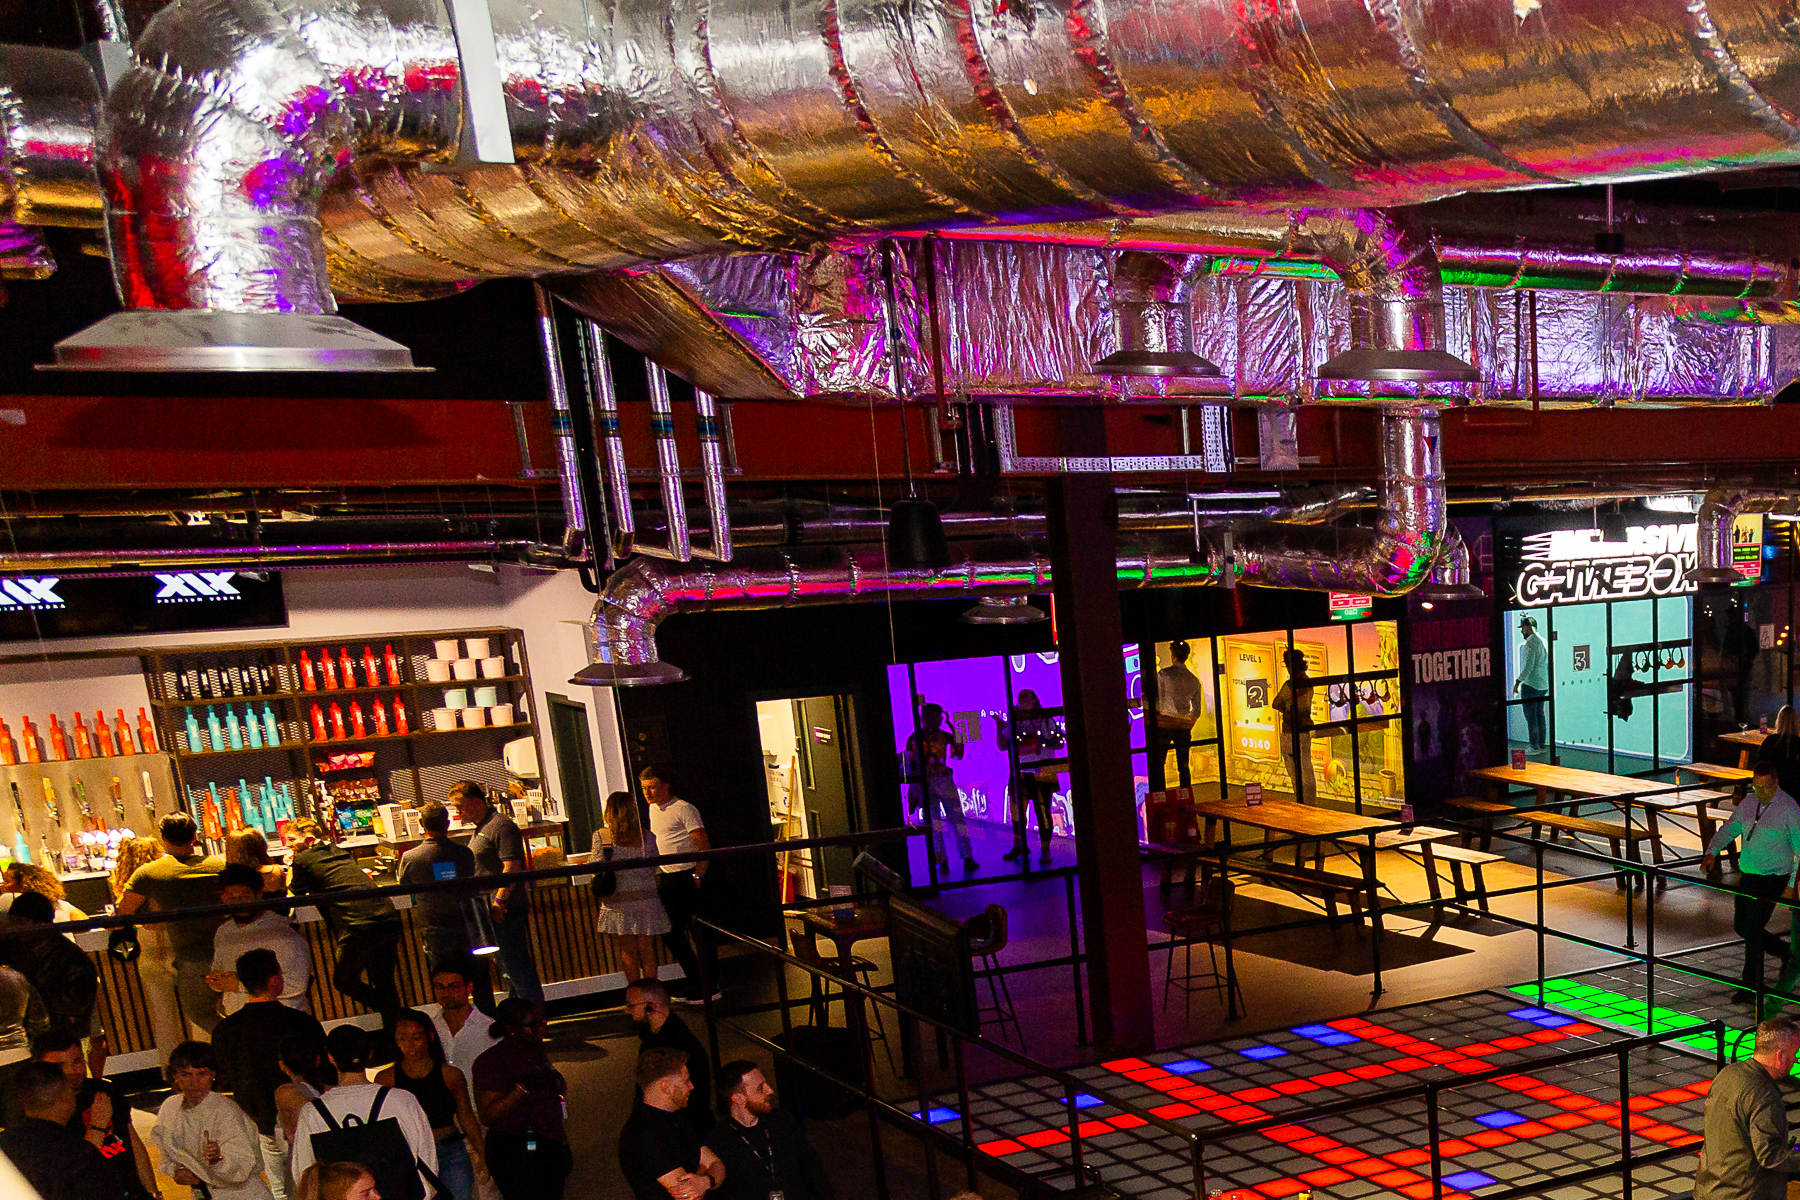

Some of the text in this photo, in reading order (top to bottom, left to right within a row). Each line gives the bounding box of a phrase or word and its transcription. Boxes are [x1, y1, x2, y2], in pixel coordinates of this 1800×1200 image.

[1517, 553, 1698, 606] GAMEBOX
[1239, 653, 1257, 663] LEVEL
[1412, 647, 1491, 684] TOGETHER
[1241, 736, 1271, 750] 03:40
